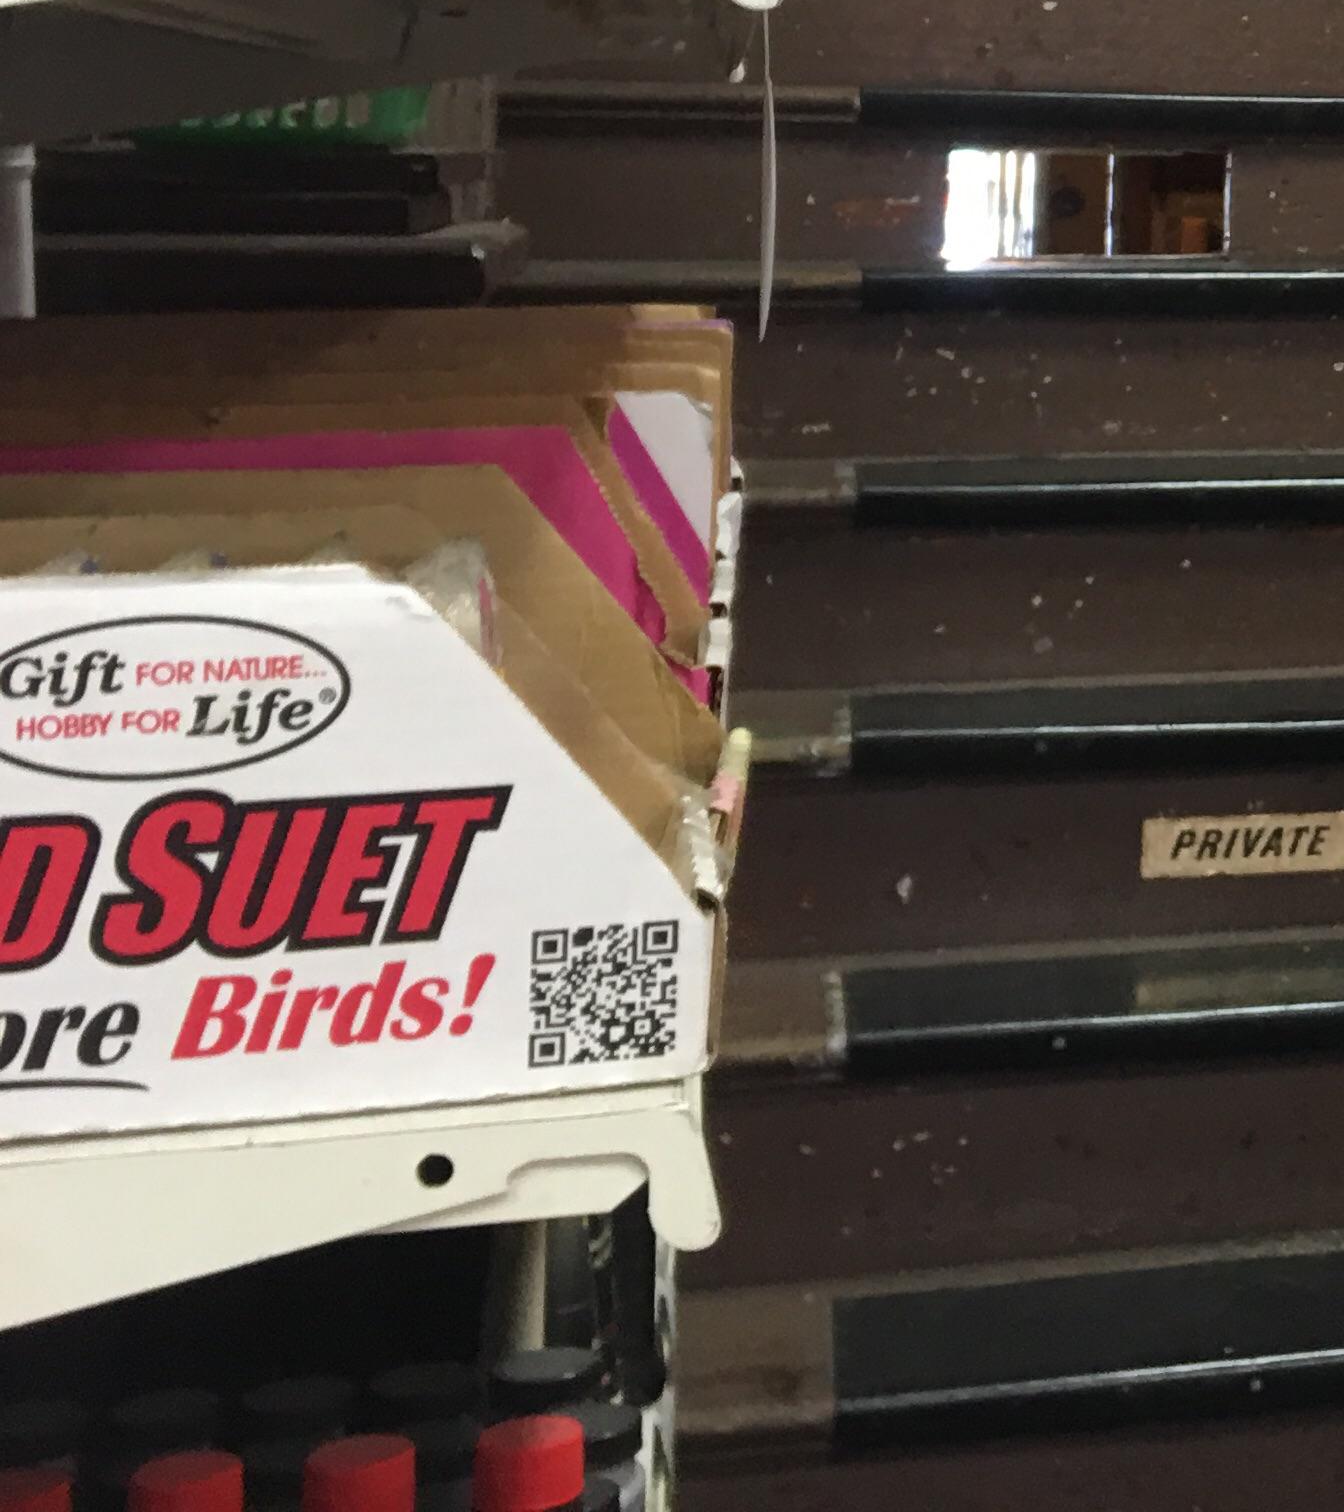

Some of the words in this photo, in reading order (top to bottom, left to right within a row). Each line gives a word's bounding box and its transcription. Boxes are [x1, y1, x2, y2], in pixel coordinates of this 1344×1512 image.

[0, 649, 126, 708] Gift
[135, 661, 195, 686] FOR
[15, 711, 113, 741] HOBBY
[121, 708, 181, 735] FOR
[185, 688, 315, 745] Life
[1171, 824, 1331, 860] PRIVATE
[90, 788, 513, 968] SUET
[170, 952, 498, 1062] Birds!
